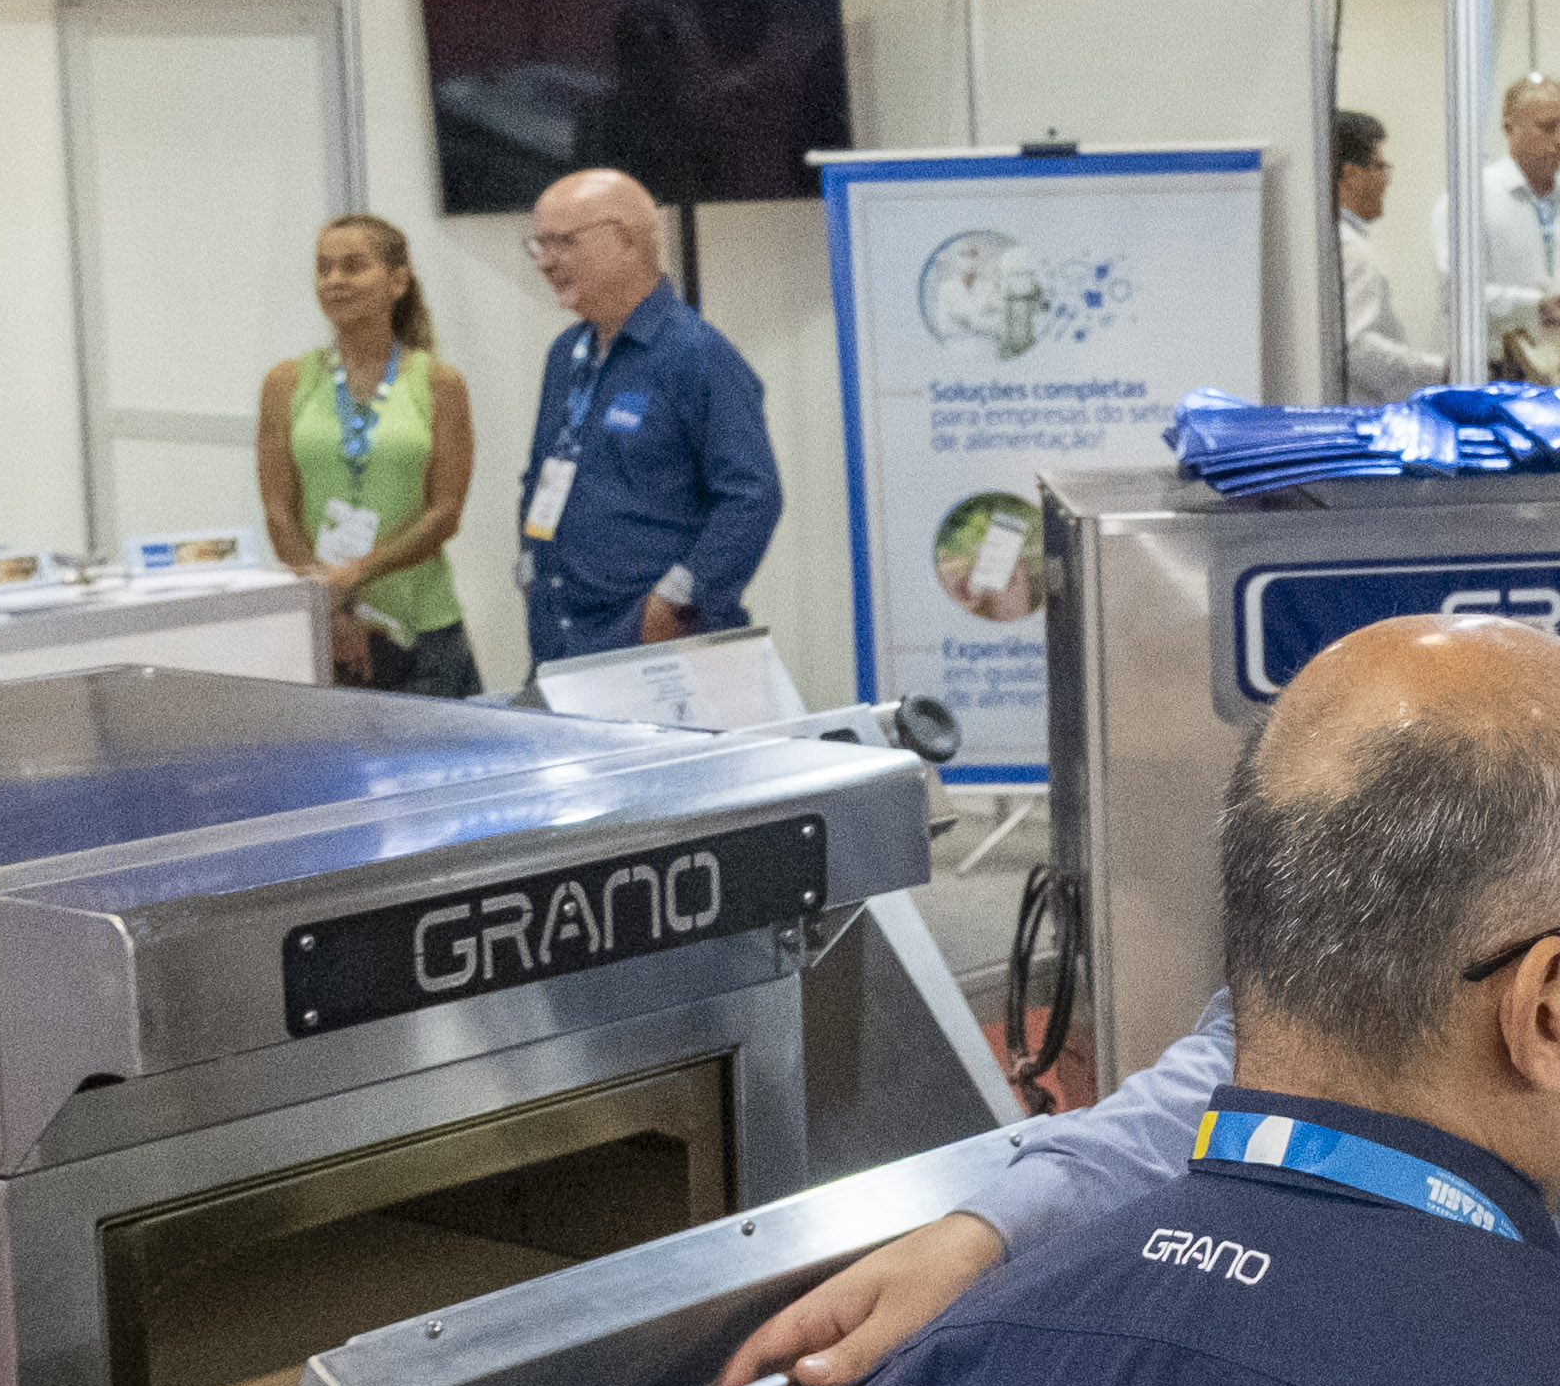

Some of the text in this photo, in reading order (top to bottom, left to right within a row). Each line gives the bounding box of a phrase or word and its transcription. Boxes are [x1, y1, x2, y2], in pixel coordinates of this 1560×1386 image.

[928, 376, 1148, 407] Soluções completas
[1128, 402, 1175, 423] seto
[413, 851, 721, 993] GRANO
[1426, 1174, 1496, 1233] BRASIL
[1142, 1227, 1272, 1286] GRANO
